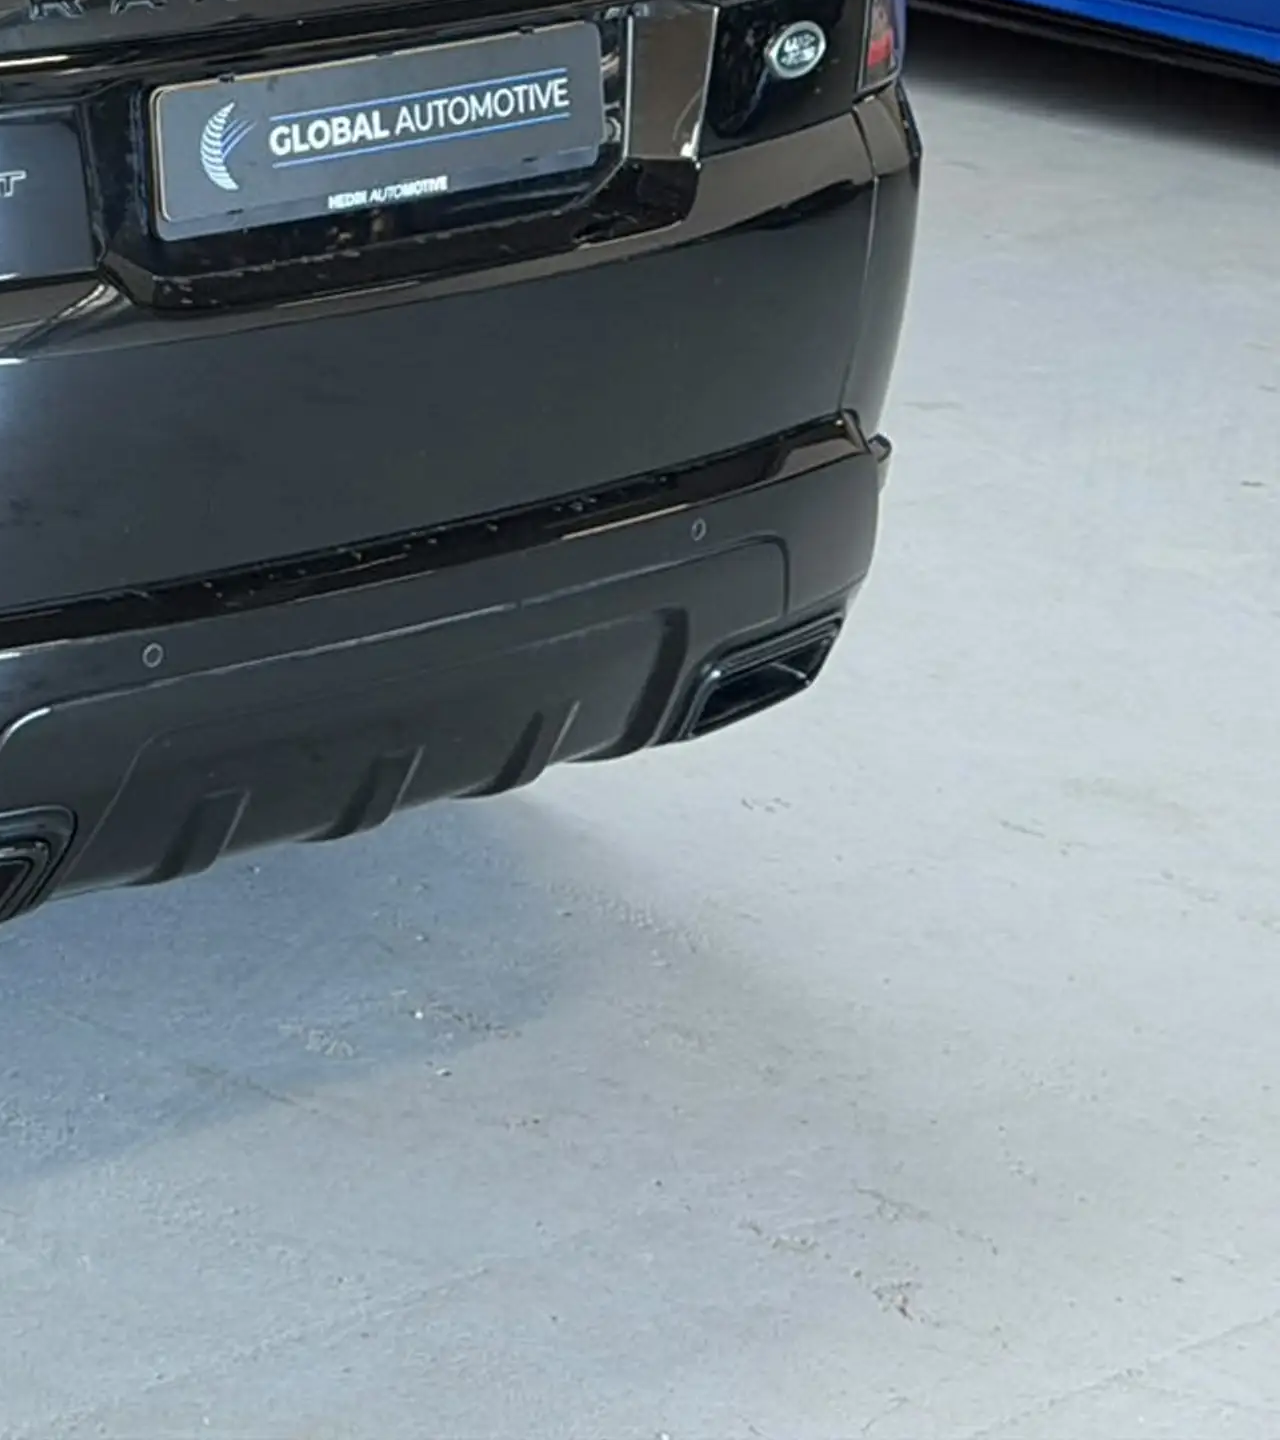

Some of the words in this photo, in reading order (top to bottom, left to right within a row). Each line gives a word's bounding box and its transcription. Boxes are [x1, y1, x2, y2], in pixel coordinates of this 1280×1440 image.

[269, 110, 391, 157] GLOBAL
[395, 76, 571, 137] AUTOMOTIVE
[369, 174, 449, 203] AUTOMOTIVE
